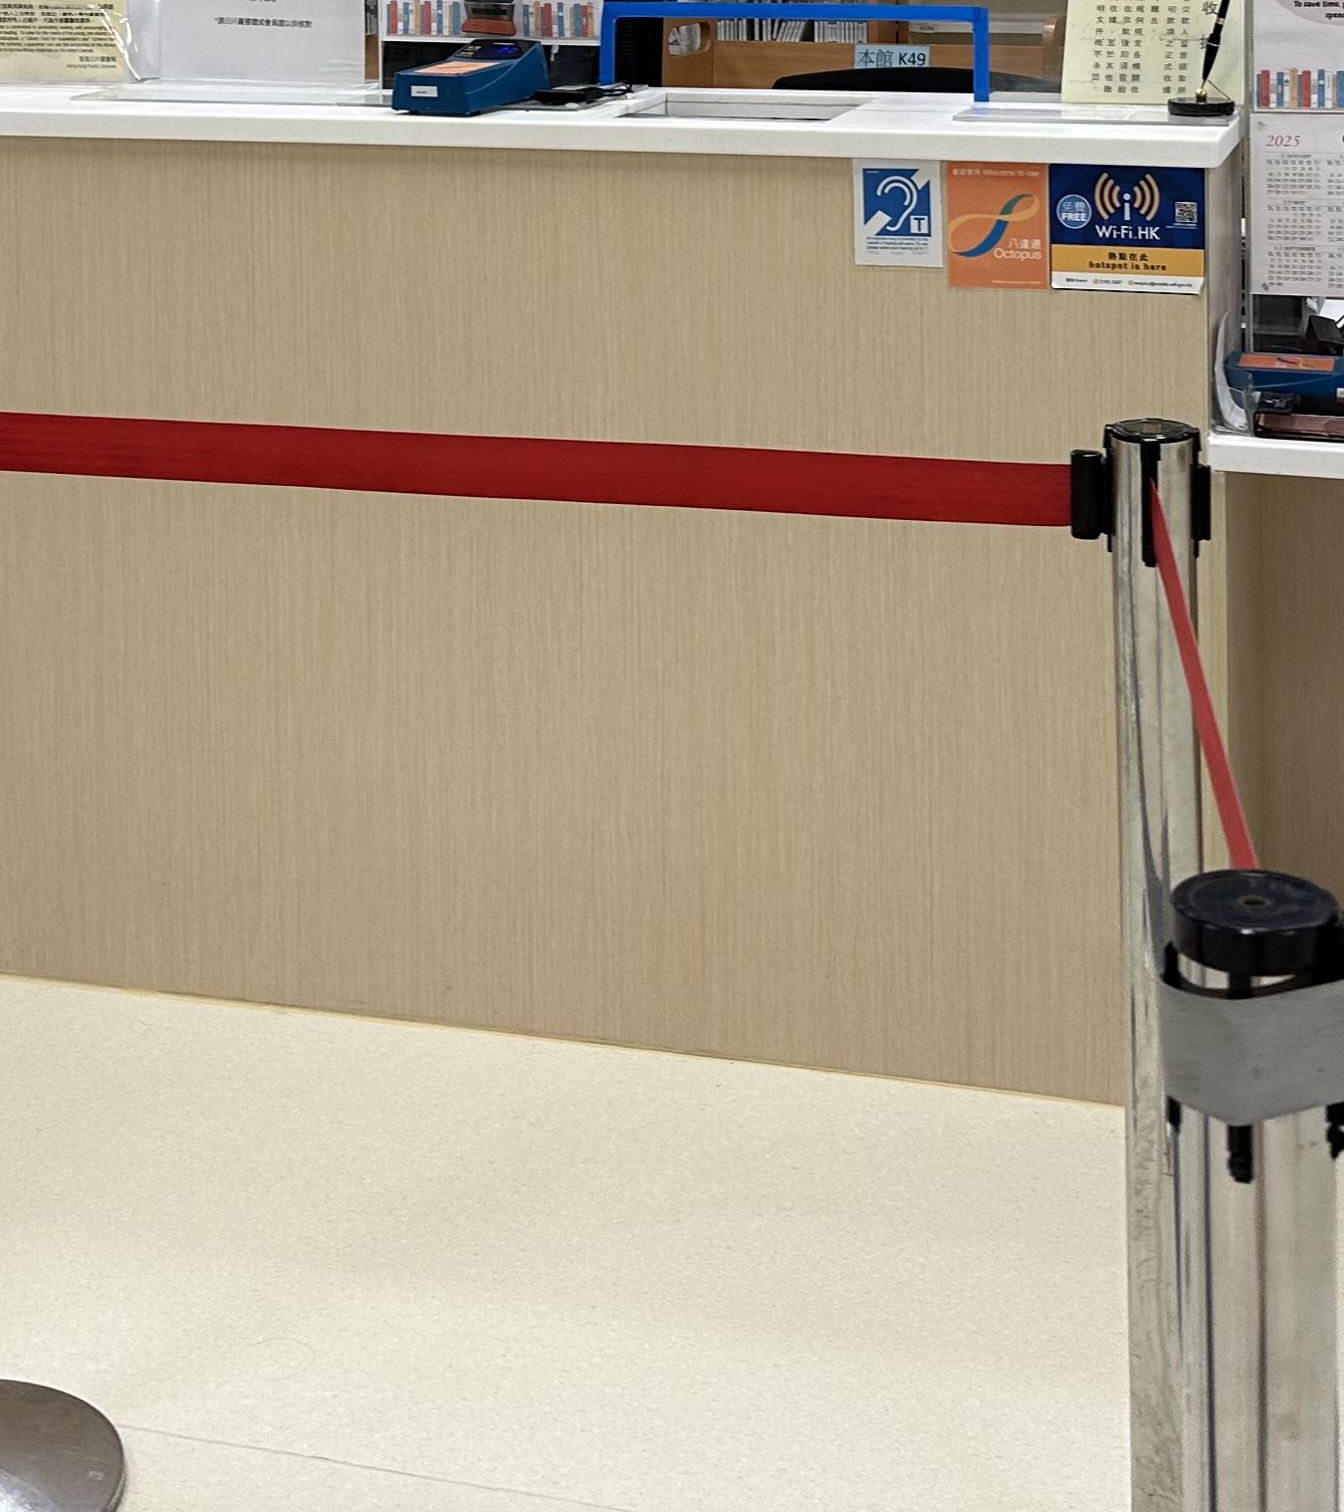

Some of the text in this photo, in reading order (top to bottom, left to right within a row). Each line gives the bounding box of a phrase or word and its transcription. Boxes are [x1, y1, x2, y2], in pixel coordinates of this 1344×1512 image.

[857, 48, 926, 68] 本館 K49
[1266, 135, 1301, 147] 2025
[1061, 212, 1087, 221] FREE
[913, 217, 925, 232] T
[1095, 224, 1161, 240] Wi-Fi.HK
[1008, 238, 1041, 249] 八達通
[993, 247, 1042, 261] Octopus
[1089, 261, 1167, 271] hotspot is here
